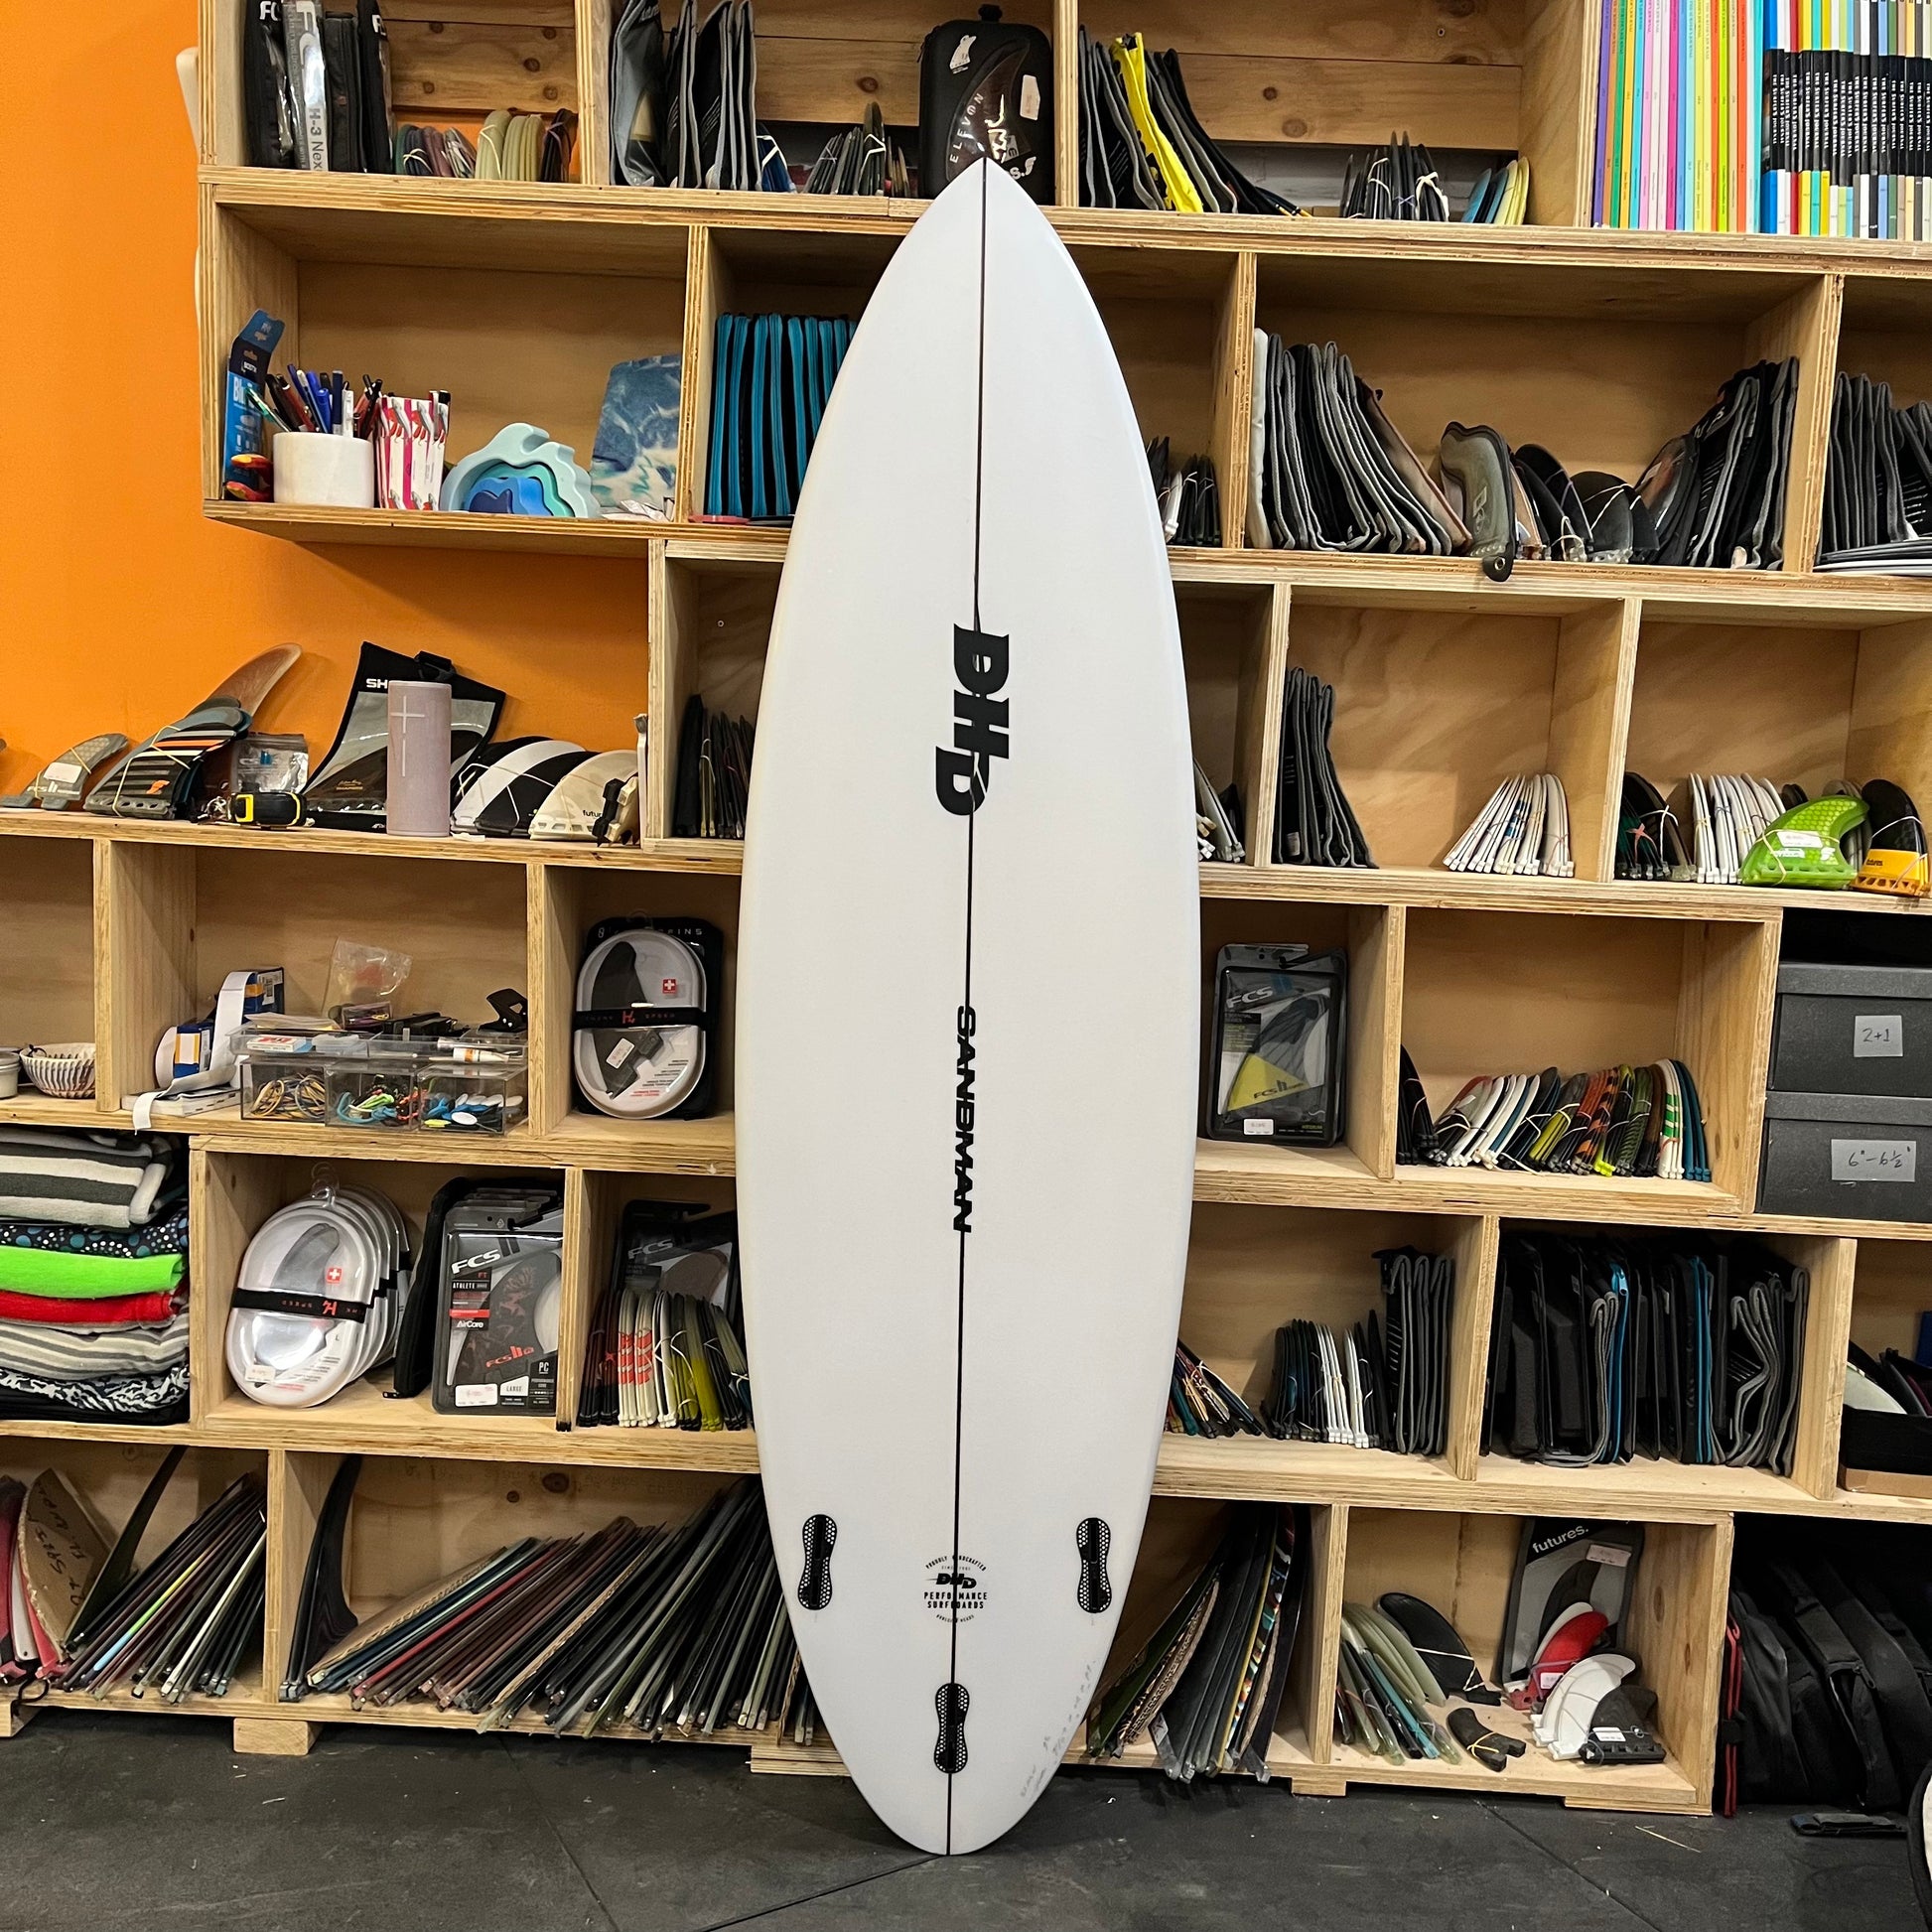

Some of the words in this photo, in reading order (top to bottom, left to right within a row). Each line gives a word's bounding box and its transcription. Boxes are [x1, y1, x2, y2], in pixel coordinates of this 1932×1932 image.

[312, 141, 325, 171] Nex
[936, 623, 1010, 816] DHD
[582, 809, 603, 818] futur
[1226, 986, 1274, 1009] FCS
[1862, 1028, 1890, 1042] 2+1
[953, 1005, 977, 1233] SANDMAN
[627, 1239, 673, 1260] FCS
[452, 1249, 501, 1275] FCS
[538, 1361, 549, 1372] PC
[936, 1573, 977, 1588] DHD
[924, 1591, 988, 1600] PERFOMANCE
